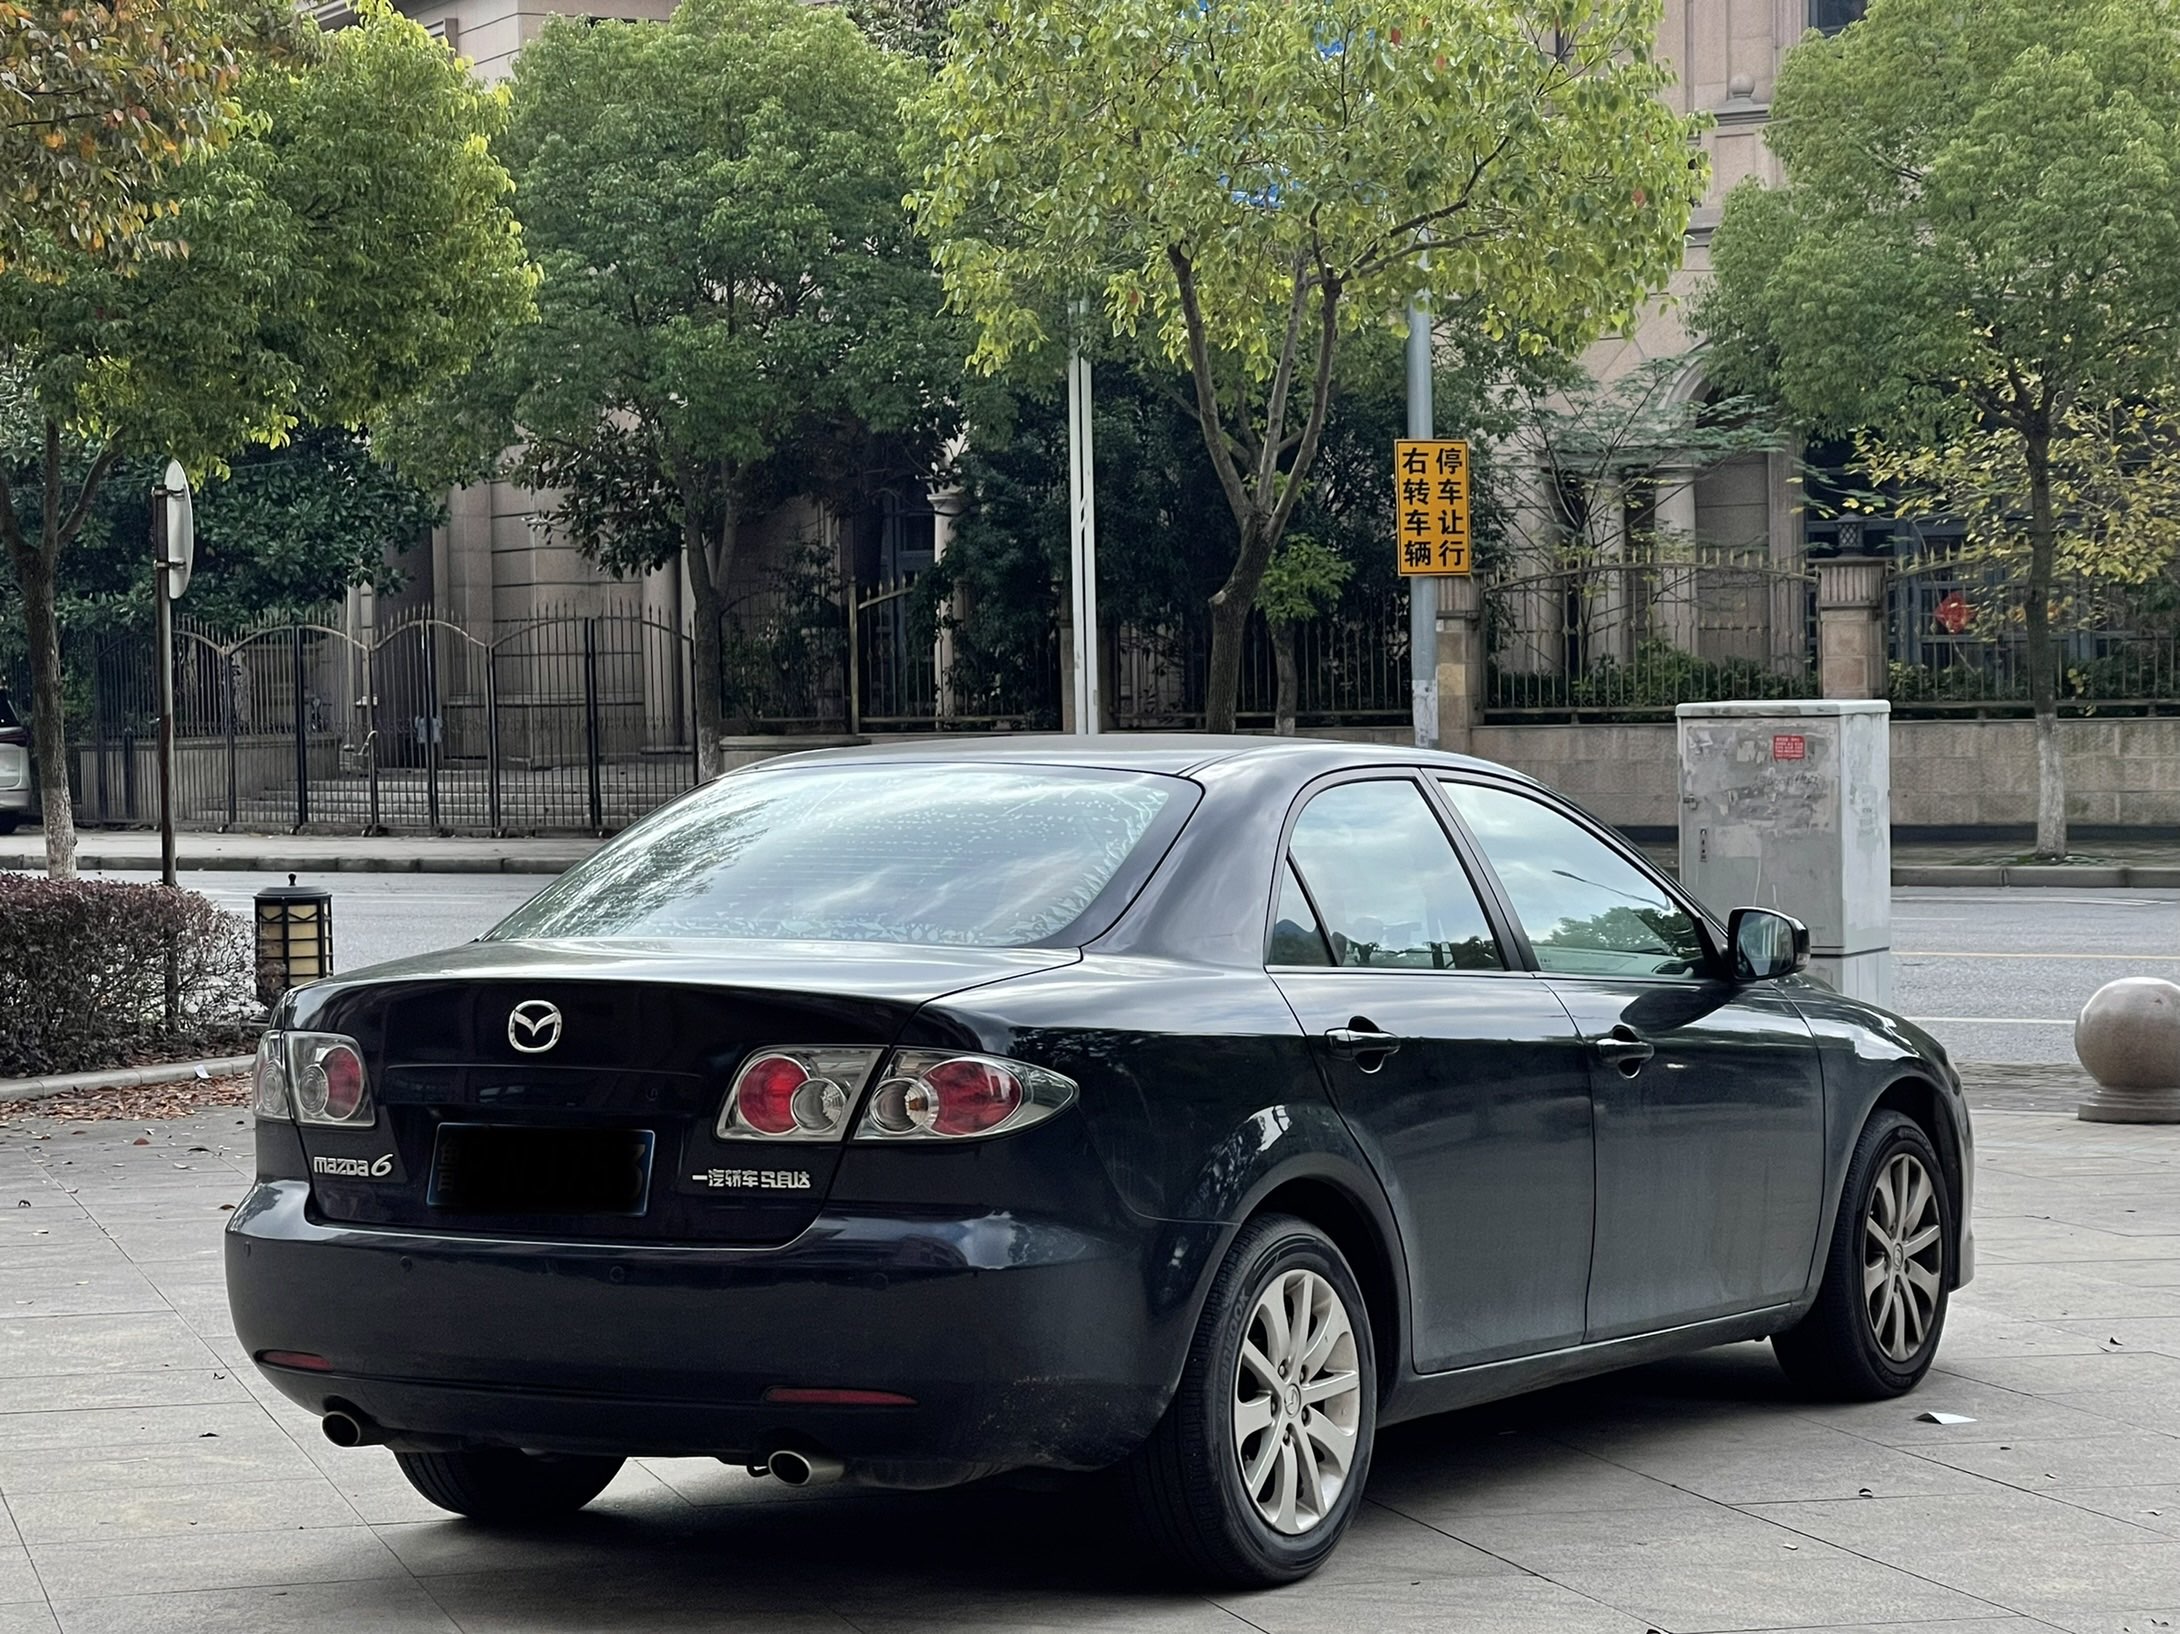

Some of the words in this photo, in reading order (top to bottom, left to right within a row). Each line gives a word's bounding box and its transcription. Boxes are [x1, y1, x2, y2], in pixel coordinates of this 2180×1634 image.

[1402, 447, 1432, 567] 右转车辆
[1436, 447, 1465, 567] 停车让行
